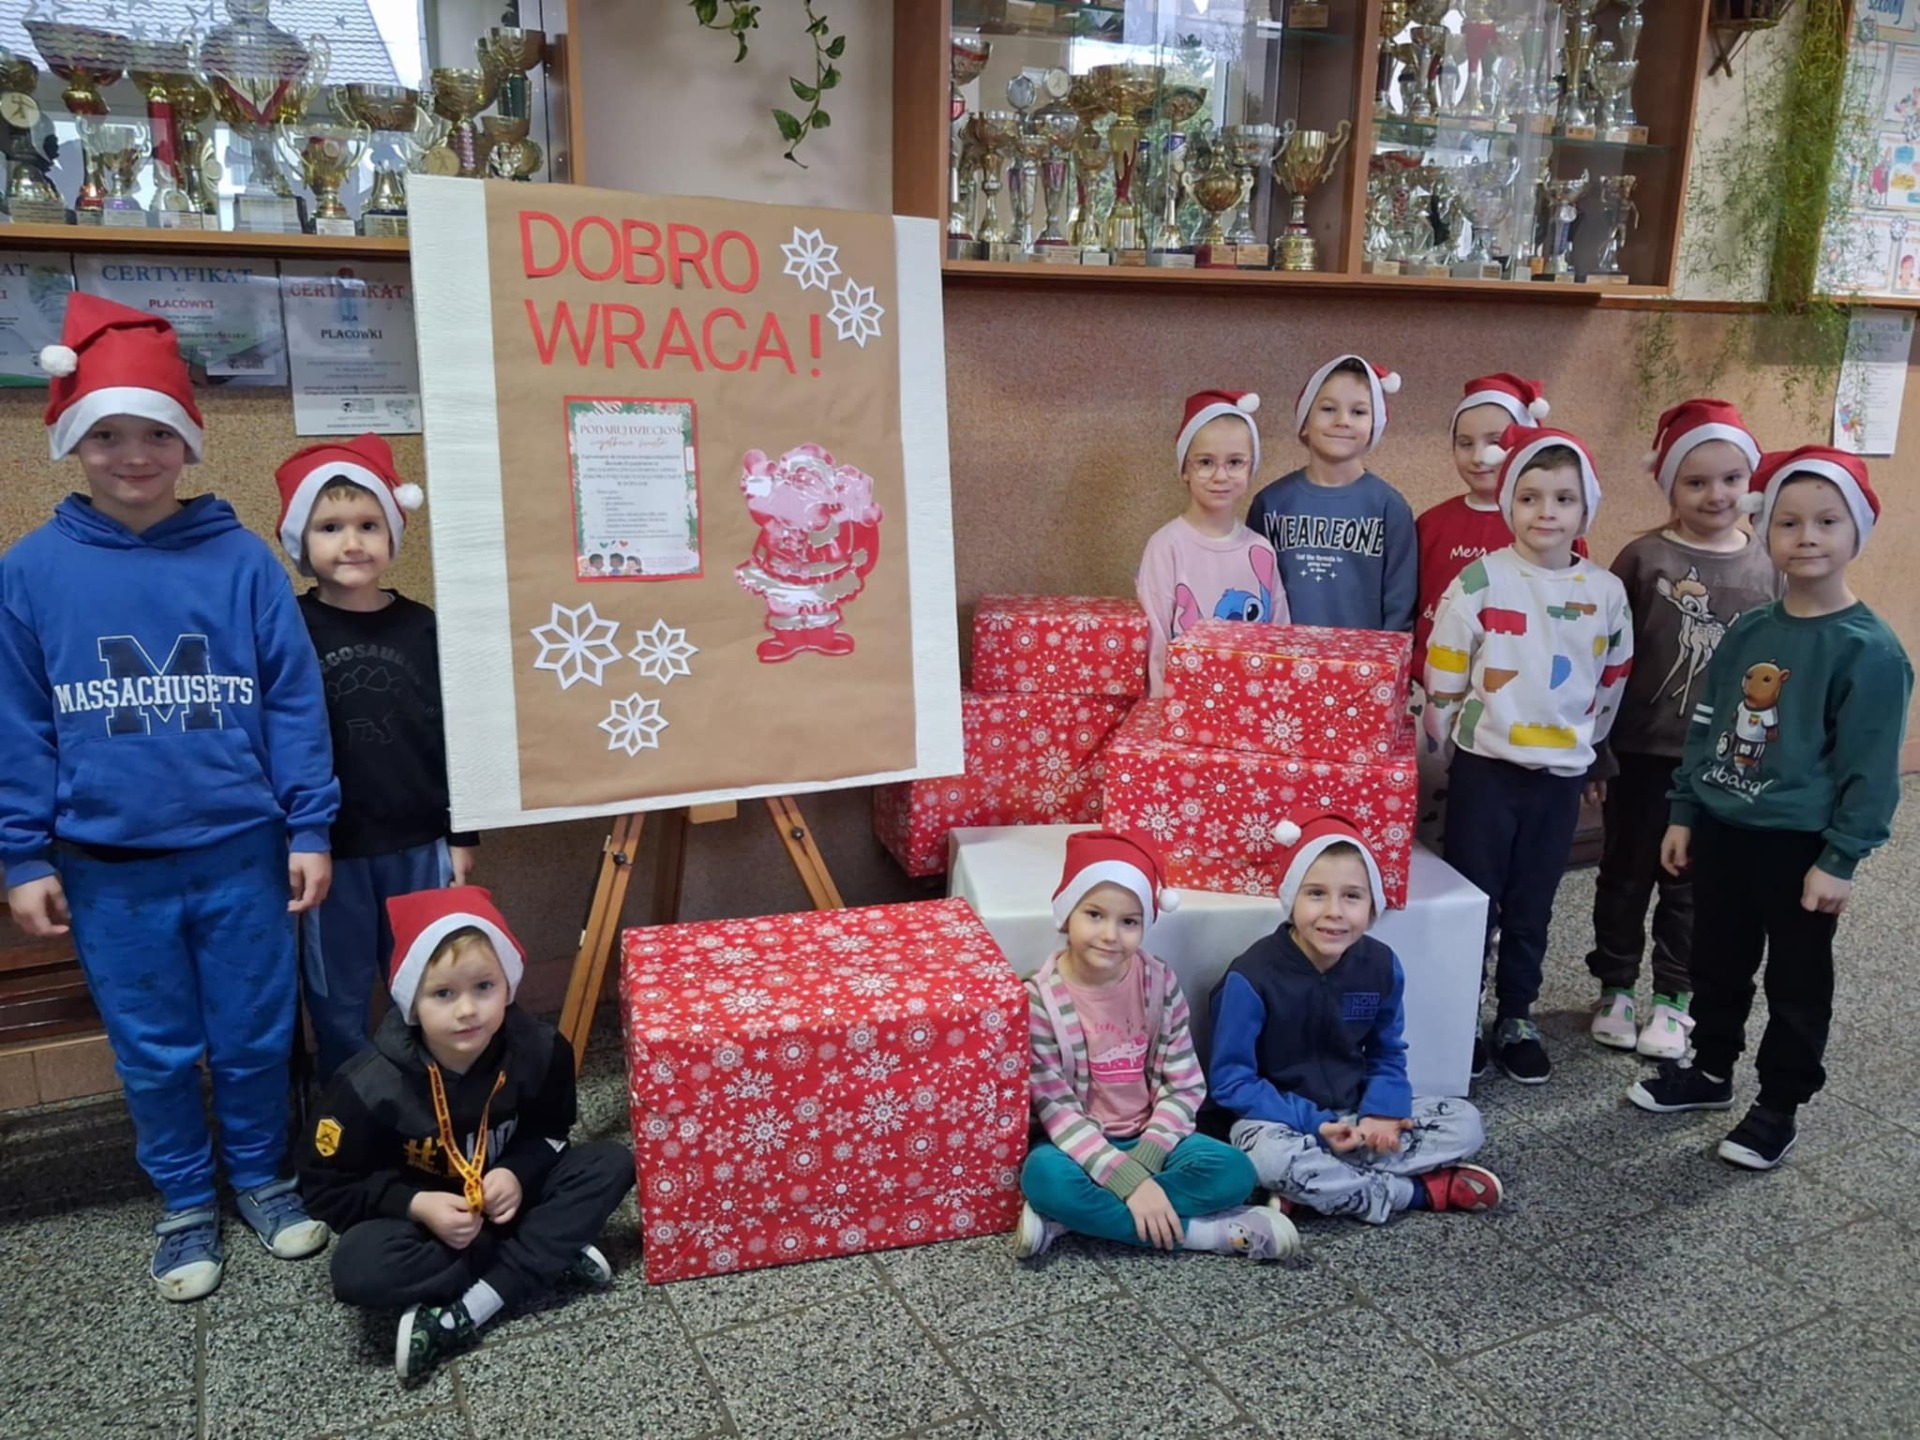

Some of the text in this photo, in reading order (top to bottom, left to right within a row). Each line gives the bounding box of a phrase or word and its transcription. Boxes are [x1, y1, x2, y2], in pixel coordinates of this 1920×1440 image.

[519, 210, 760, 294] DOBRO
[102, 265, 253, 283] CERTYFIKAT
[290, 283, 404, 299] CERTFIKAT
[1449, 544, 1487, 561] Merr
[53, 674, 254, 713] MASSACHUSETS
